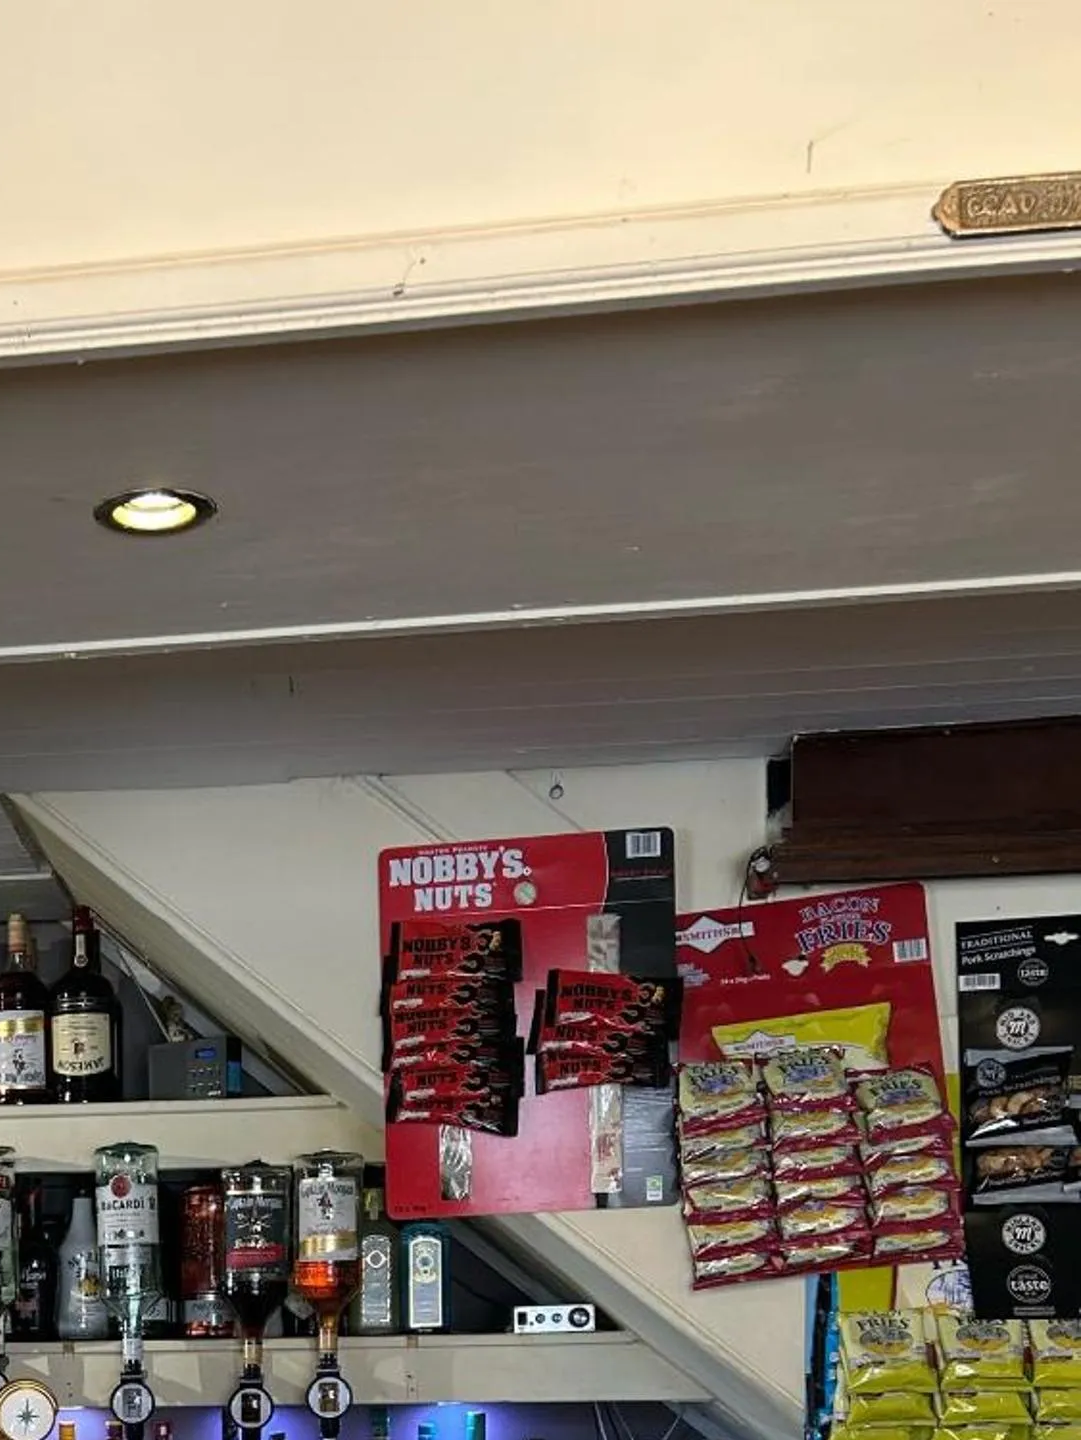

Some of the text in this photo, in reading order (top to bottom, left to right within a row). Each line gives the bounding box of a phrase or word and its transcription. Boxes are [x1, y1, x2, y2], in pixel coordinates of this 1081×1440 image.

[389, 847, 524, 887] NOBBY'S
[414, 882, 493, 912] NUTS
[798, 896, 880, 924] BACON
[794, 919, 892, 956] FRIES
[960, 930, 1034, 951] TRADITIONAL
[961, 945, 1037, 967] Pork Scratchings
[57, 1056, 105, 1071] JAMESON
[1010, 1280, 1049, 1292] taste
